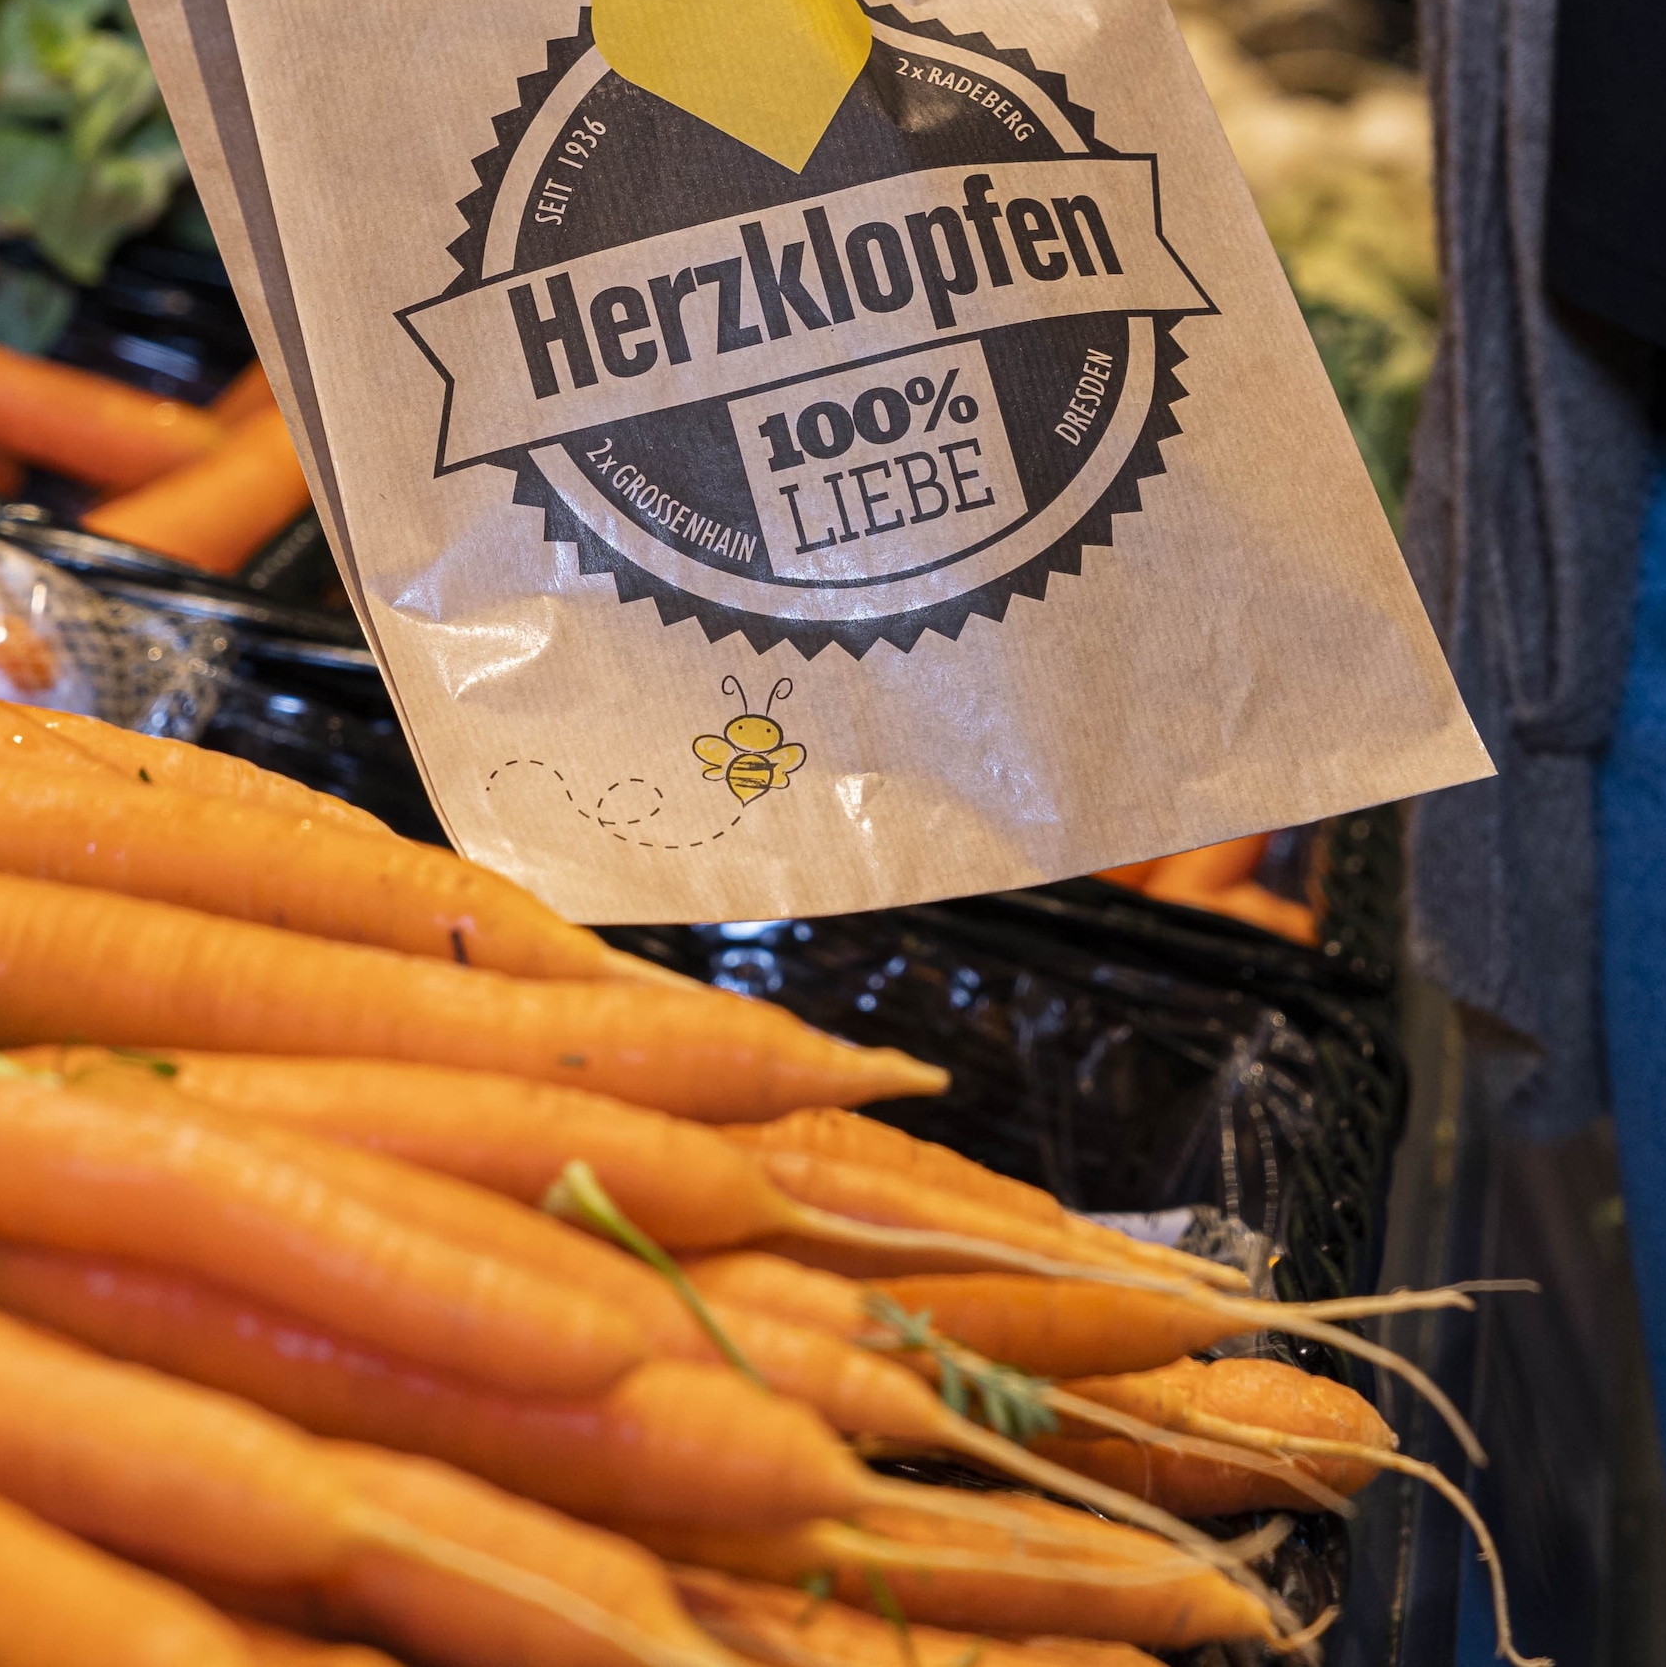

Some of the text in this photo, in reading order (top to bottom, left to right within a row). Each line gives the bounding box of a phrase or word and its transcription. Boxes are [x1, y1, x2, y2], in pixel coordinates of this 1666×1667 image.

[927, 66, 1036, 143] RADEBERG
[534, 115, 607, 226] SEIT 1936
[507, 173, 1124, 400] Herzklopfen
[758, 367, 980, 473] 100%
[1054, 348, 1114, 447] DRESDEN
[611, 463, 758, 565] GROSSENHAIN
[779, 437, 996, 555] LIEBE
